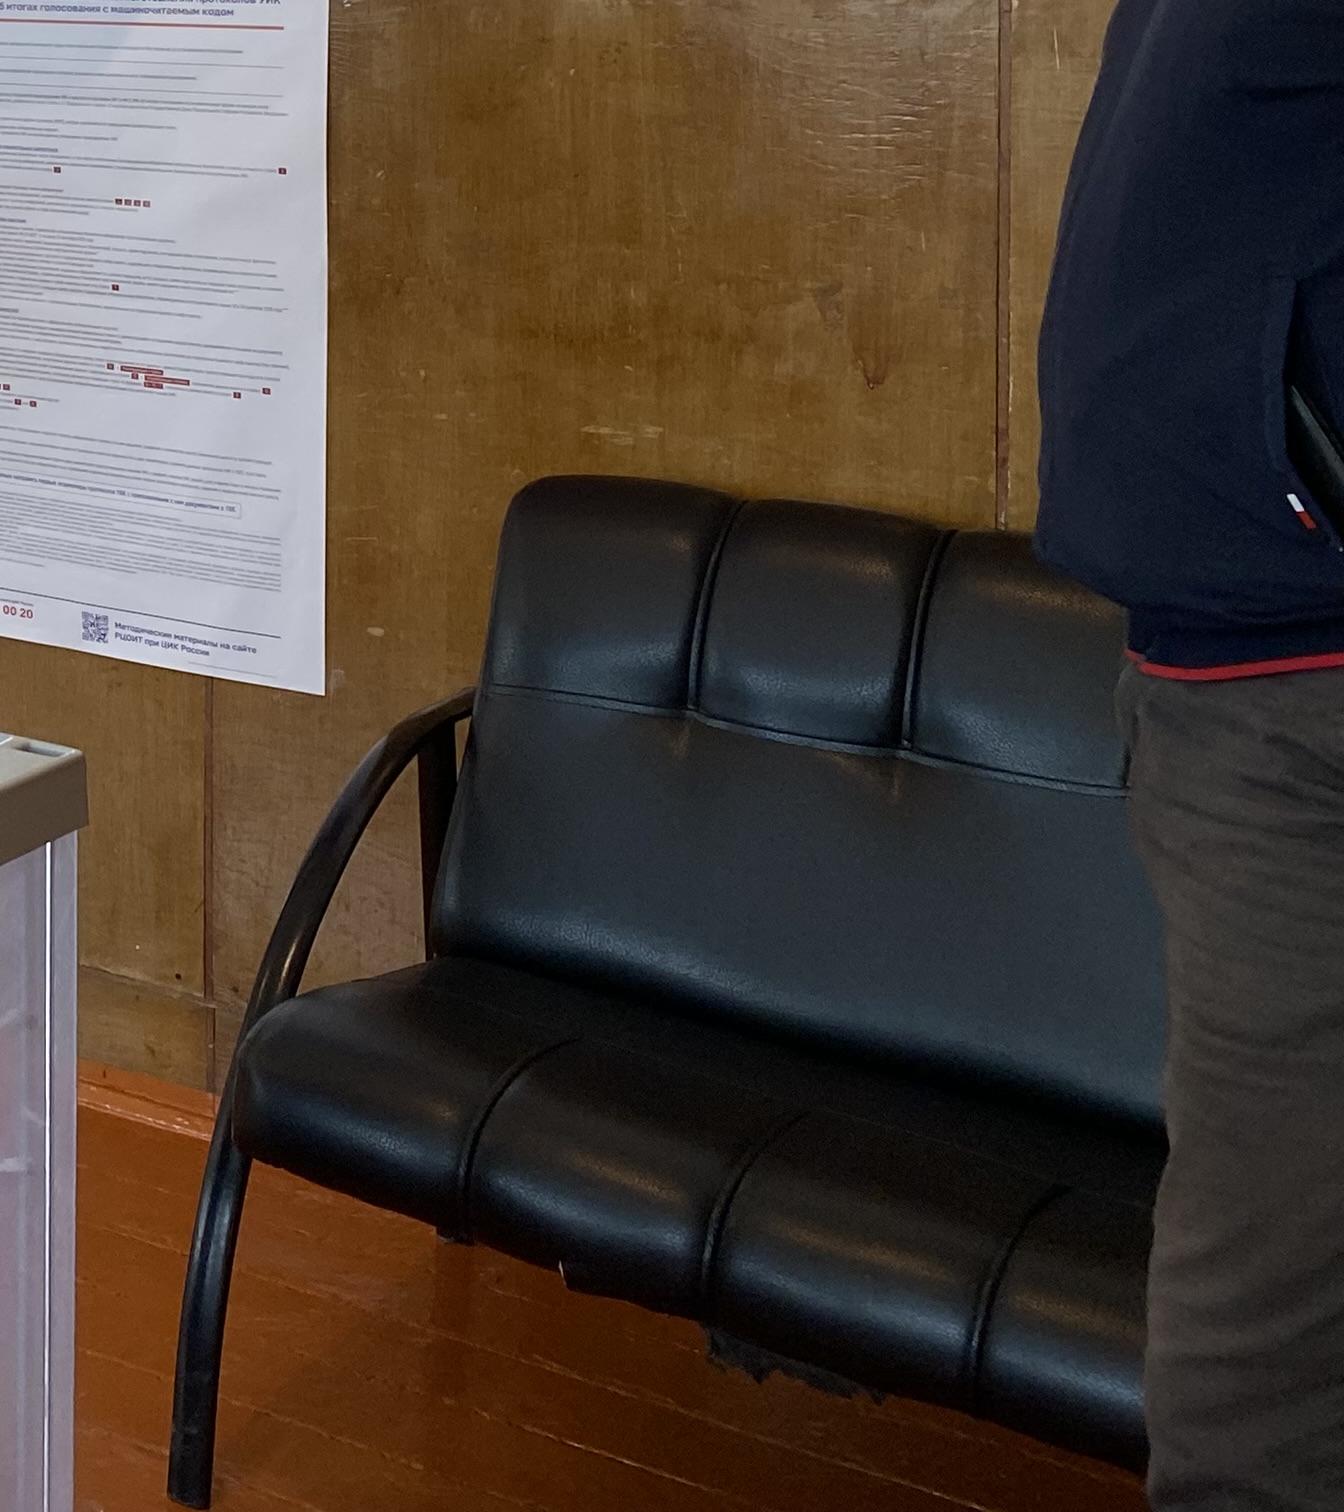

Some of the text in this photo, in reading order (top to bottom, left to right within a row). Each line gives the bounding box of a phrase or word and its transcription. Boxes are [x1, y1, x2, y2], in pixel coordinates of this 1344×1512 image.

[202, 8, 234, 17] кодом
[3, 604, 17, 616] 00
[20, 607, 34, 619] 20
[115, 622, 172, 639] Методические
[174, 634, 218, 648] материалы
[232, 644, 257, 654] сайте
[115, 632, 210, 656] РЦОИТ при ЦИК России
